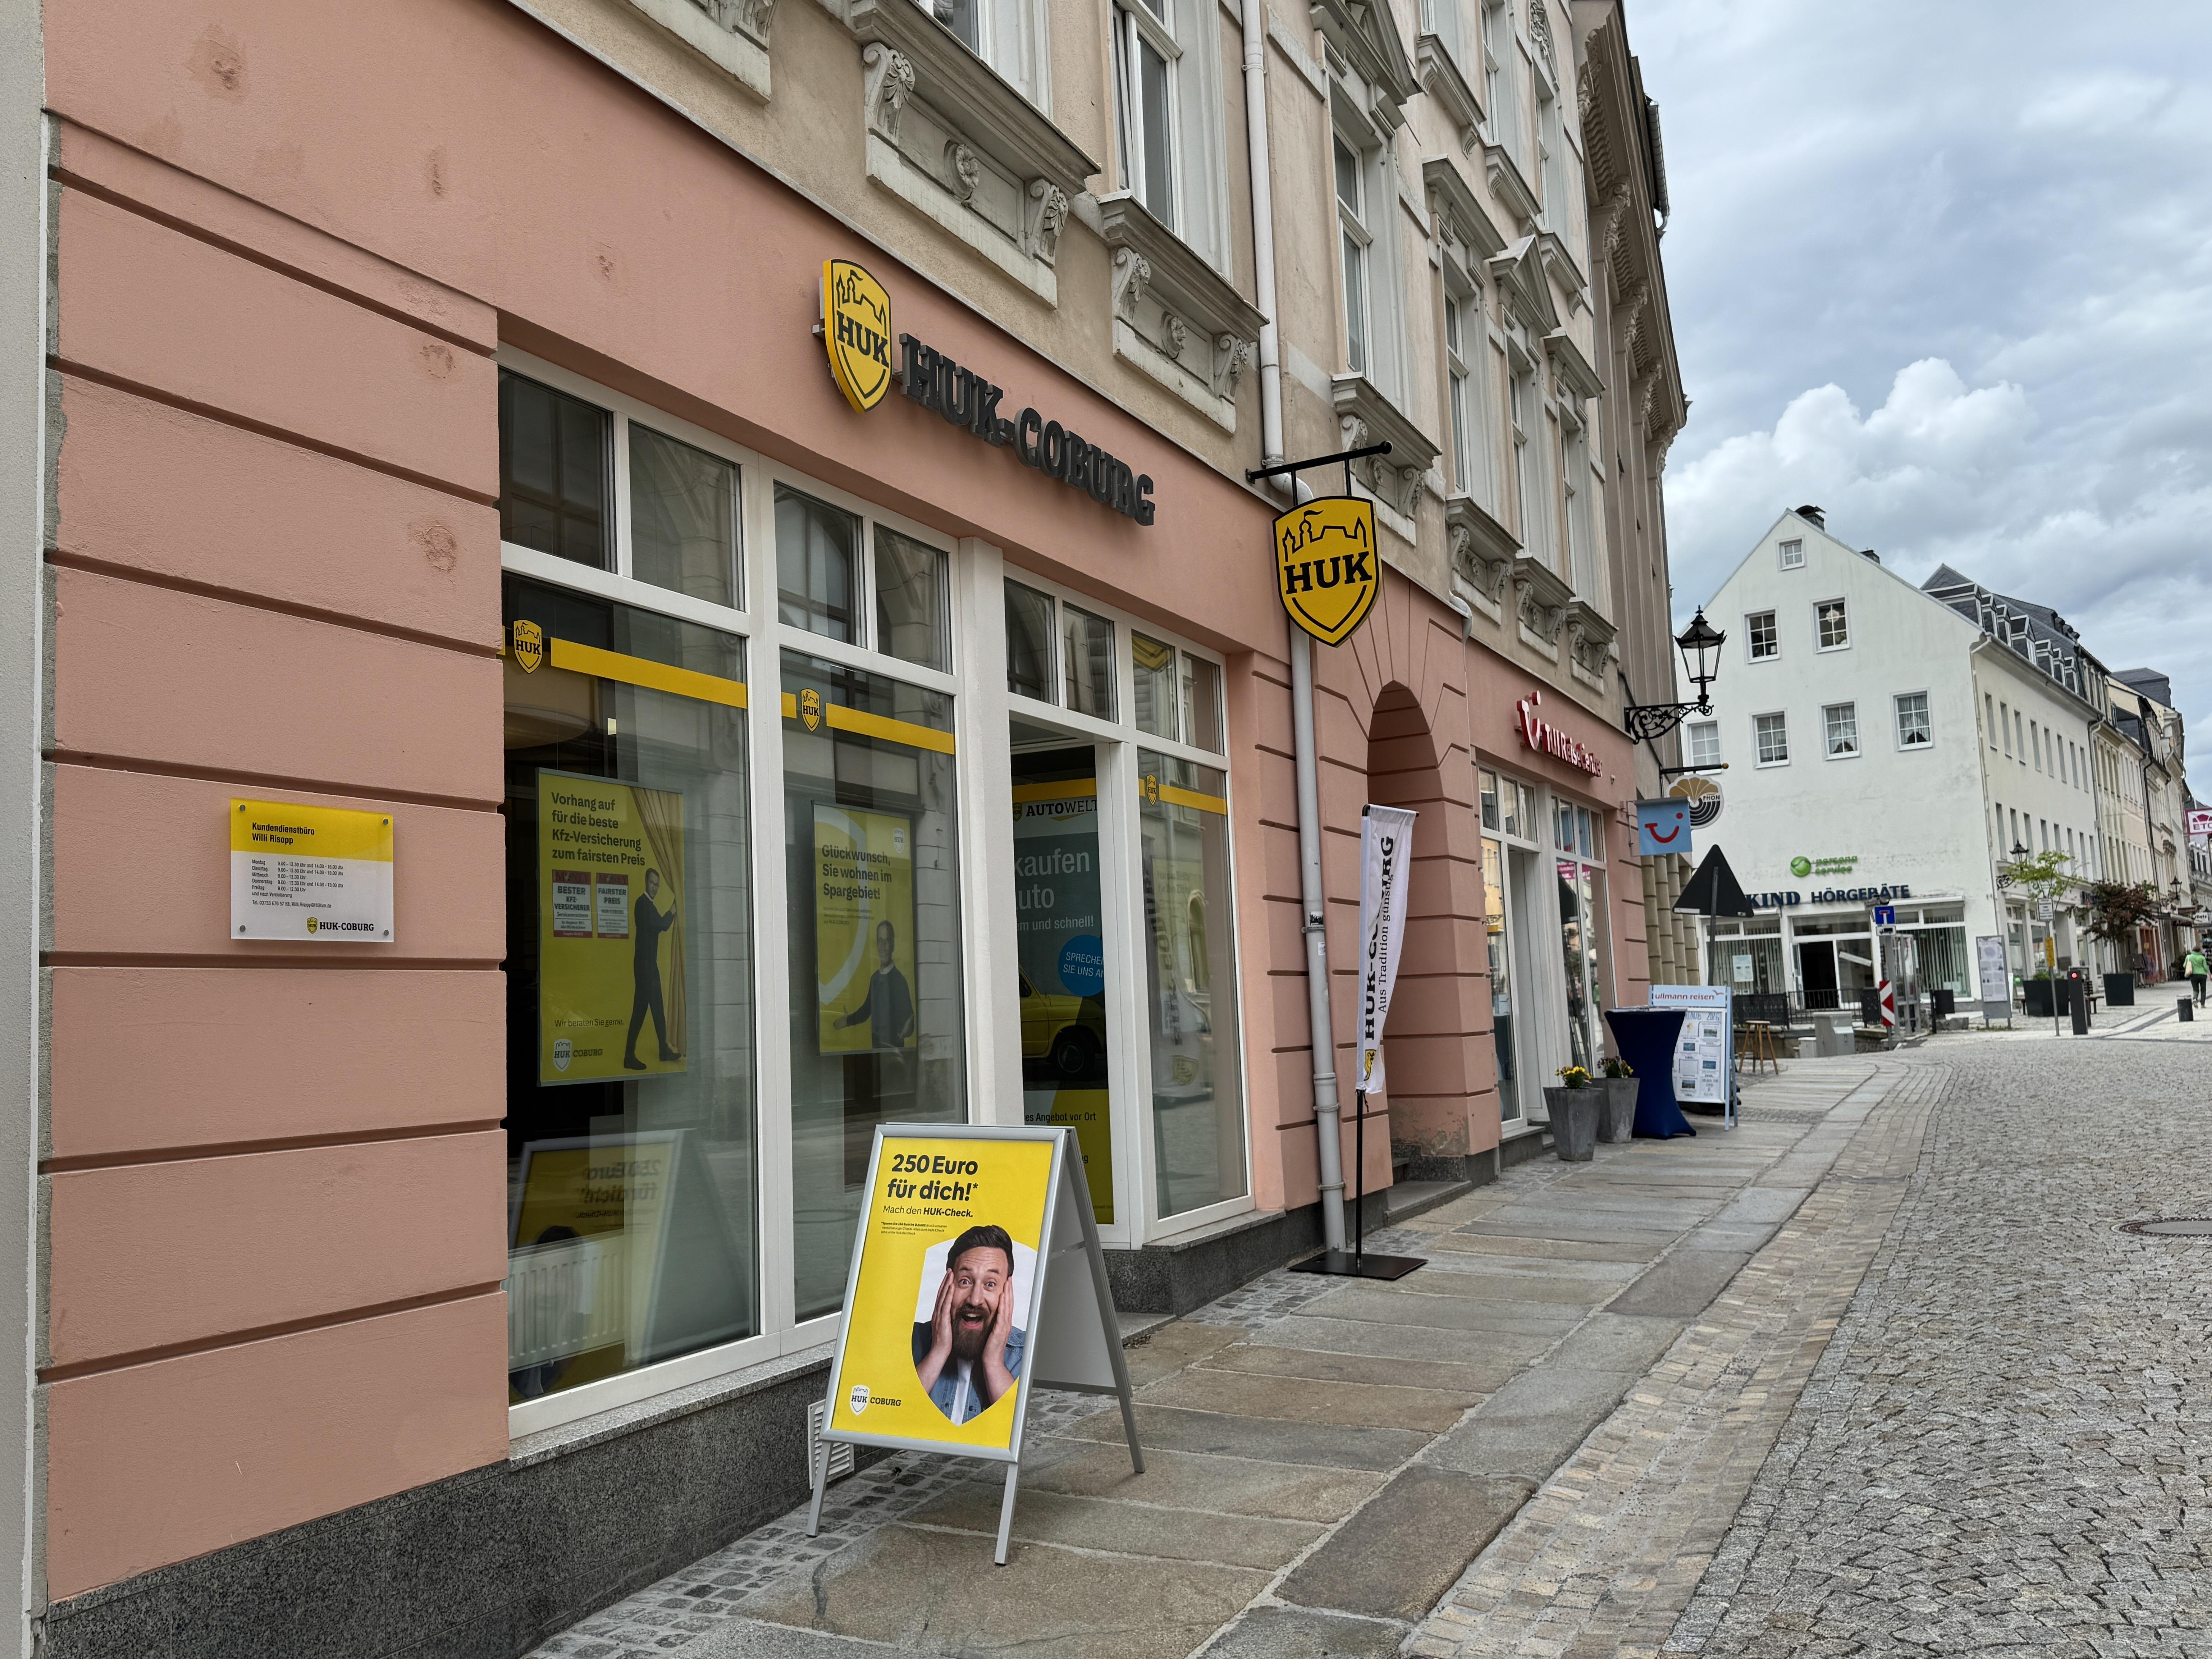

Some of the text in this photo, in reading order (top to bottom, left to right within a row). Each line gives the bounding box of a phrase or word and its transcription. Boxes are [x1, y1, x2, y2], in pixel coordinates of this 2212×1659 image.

[837, 311, 889, 366] HUK
[899, 333, 1155, 526] HUK-COBURG
[1284, 551, 1372, 594] HUK
[516, 639, 541, 656] HUK
[803, 706, 819, 716] HUK
[1148, 787, 1156, 795] HUK
[551, 792, 615, 812] Vorhang auf
[1026, 800, 1097, 817] AUTOWELT
[552, 810, 618, 829] für die beste
[252, 822, 314, 835] Kundendienstbüro
[252, 833, 293, 845] Willi Risopp
[553, 829, 641, 851] Kfz-Versicherung
[552, 848, 645, 866] zum fairsten Preis
[822, 844, 890, 866] Glückwunsch,
[823, 863, 892, 883] Sie wohnen im
[558, 886, 586, 895] BESTER
[823, 883, 881, 901] Spargebiet!
[1016, 884, 1054, 910] uto
[1744, 883, 1910, 908] KIND HÖRGERÄTE
[320, 922, 374, 931] HUK-COBURG
[1032, 918, 1051, 930] und
[1054, 915, 1094, 929] schnell!
[1066, 951, 1103, 965] SPRECHE
[1379, 926, 1388, 985] Tradition
[1063, 964, 1075, 974] SIE
[1078, 966, 1094, 977] UNS
[568, 1019, 593, 1027] beraten
[605, 1019, 624, 1027] gerne.
[573, 1049, 603, 1057] COBURG
[1036, 1113, 1068, 1122] Angebot
[1070, 1113, 1082, 1121] vor
[1084, 1112, 1096, 1121] Ort
[891, 1154, 978, 1175] 250 Euro
[887, 1178, 917, 1198] für
[883, 1205, 973, 1217] Mach den HUK-Check.
[851, 1395, 901, 1407] HUK COBURG
